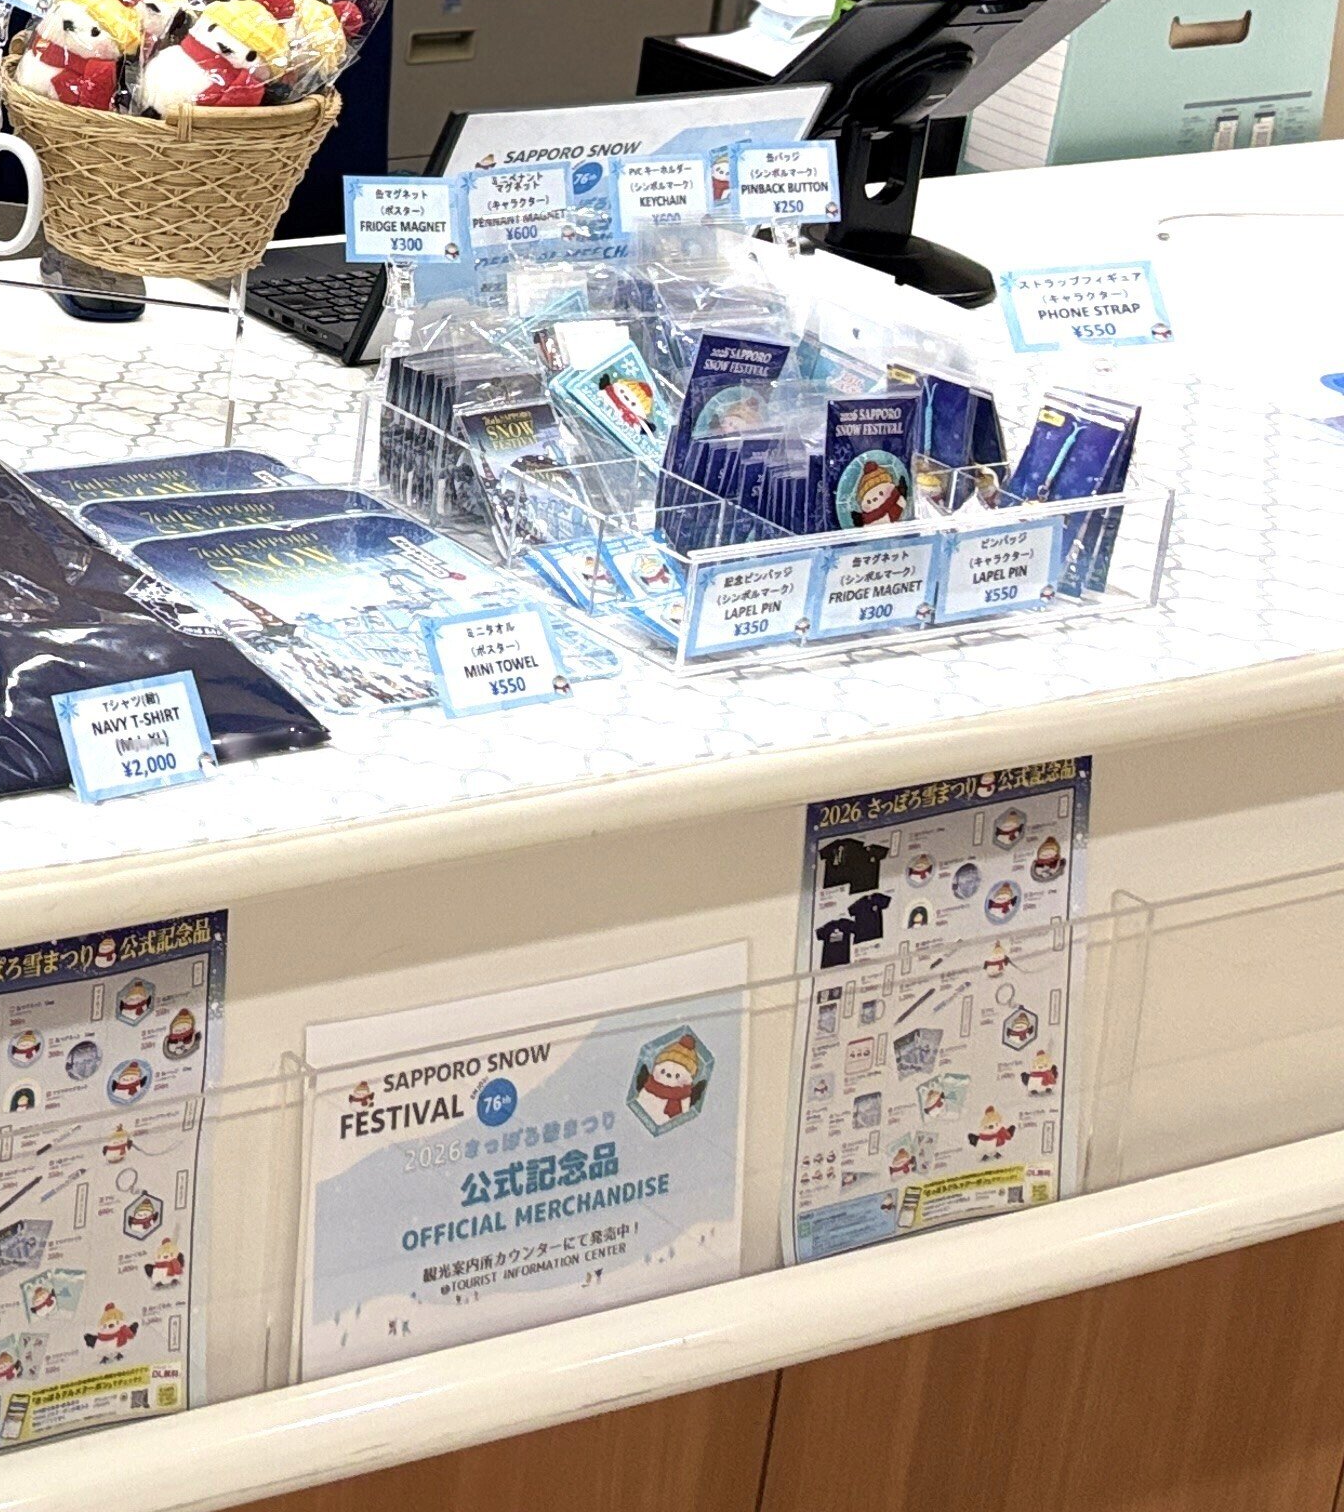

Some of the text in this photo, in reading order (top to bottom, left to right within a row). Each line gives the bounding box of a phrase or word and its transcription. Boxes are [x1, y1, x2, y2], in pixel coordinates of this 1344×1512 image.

[503, 140, 643, 164] SAPPORO SNOW
[740, 181, 829, 195] PINBACK BUTTON
[638, 195, 687, 208] KEYCHAIN
[773, 199, 805, 214] ¥250
[359, 220, 447, 233] FRIDGE MAGNET
[504, 224, 539, 241] ¥600
[390, 237, 423, 252] ¥300
[1037, 302, 1141, 321] PHONE STRAP
[1071, 322, 1117, 338] ¥550
[728, 346, 774, 364] SAPPORO
[702, 358, 769, 378] SNOW FESTIVAL
[858, 406, 903, 422] SAPPORO
[484, 420, 537, 441] SNOW
[834, 419, 905, 438] SNOW FESTIVAL
[207, 545, 338, 578] SNOW
[972, 564, 1029, 585] LAPEL PIN
[828, 579, 924, 605] FRIDGE MAGNET
[984, 584, 1019, 604] ¥550
[724, 599, 782, 622] LAPEL PIN
[858, 602, 894, 622] ¥300
[733, 618, 770, 637] ¥350
[463, 655, 540, 679] MINI TOWEL
[488, 676, 526, 696] ¥550
[91, 706, 180, 737] NAVY T-SHIRT
[121, 752, 177, 778] ¥2,000
[818, 802, 862, 828] 2026
[118, 918, 212, 960] 公式記念品
[382, 1042, 552, 1094] SAPPORO SNOW
[338, 1093, 465, 1140] FESTIVAL
[460, 1140, 620, 1208] 公式記念品
[401, 1172, 670, 1253] OFFICIAL MERCHANDISE
[502, 1241, 627, 1281] INFORMATION CENTER
